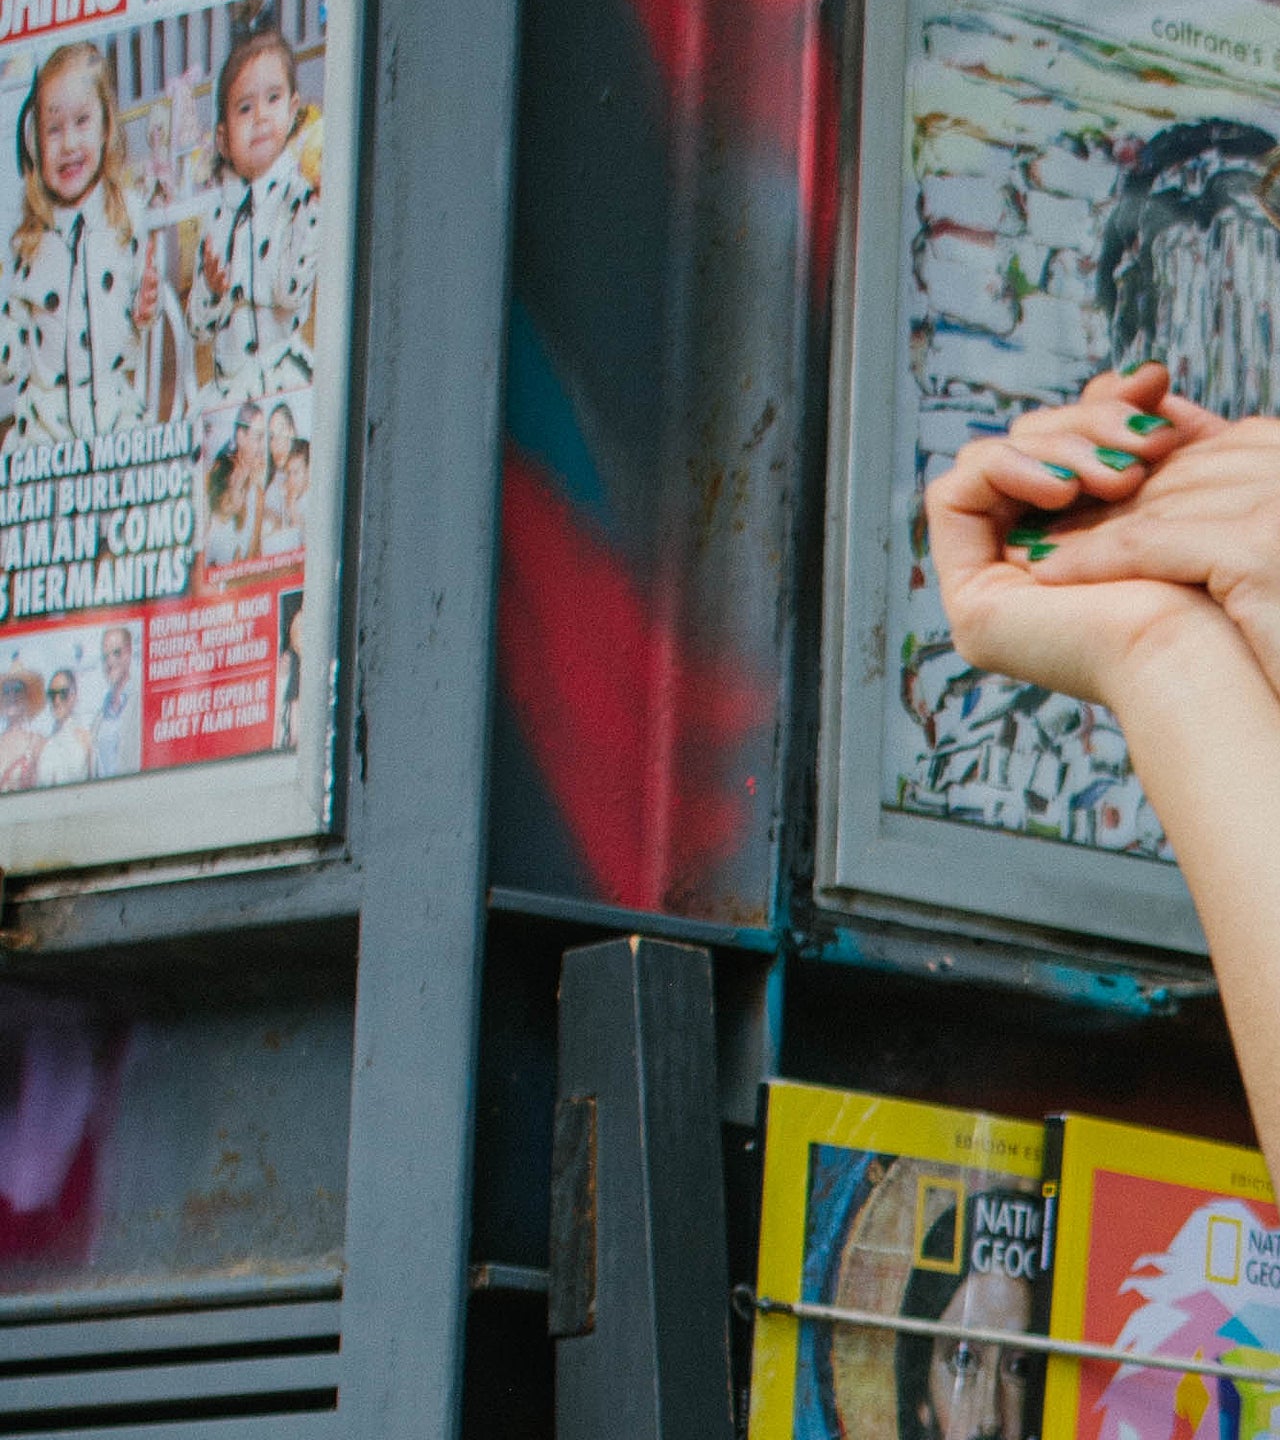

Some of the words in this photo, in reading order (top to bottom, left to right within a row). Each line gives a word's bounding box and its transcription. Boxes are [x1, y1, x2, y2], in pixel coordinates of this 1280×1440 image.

[10, 439, 90, 484] GARCIA
[92, 420, 194, 472] MORITAN
[106, 498, 196, 556] COMO
